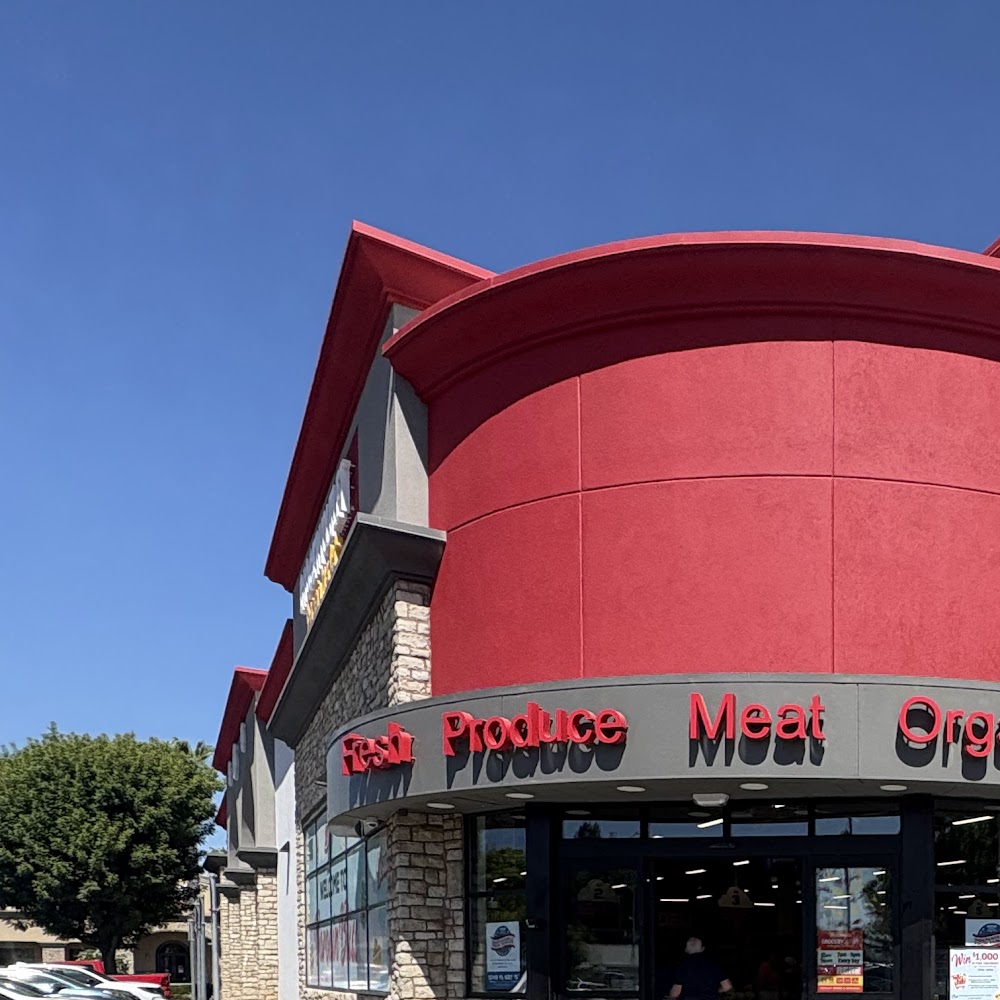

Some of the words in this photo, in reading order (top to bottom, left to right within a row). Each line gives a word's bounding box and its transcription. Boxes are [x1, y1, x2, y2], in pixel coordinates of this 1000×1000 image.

[442, 701, 629, 757] Produce
[688, 692, 827, 741] Meat
[951, 952, 972, 968] Win
[972, 951, 999, 962] $1,000
